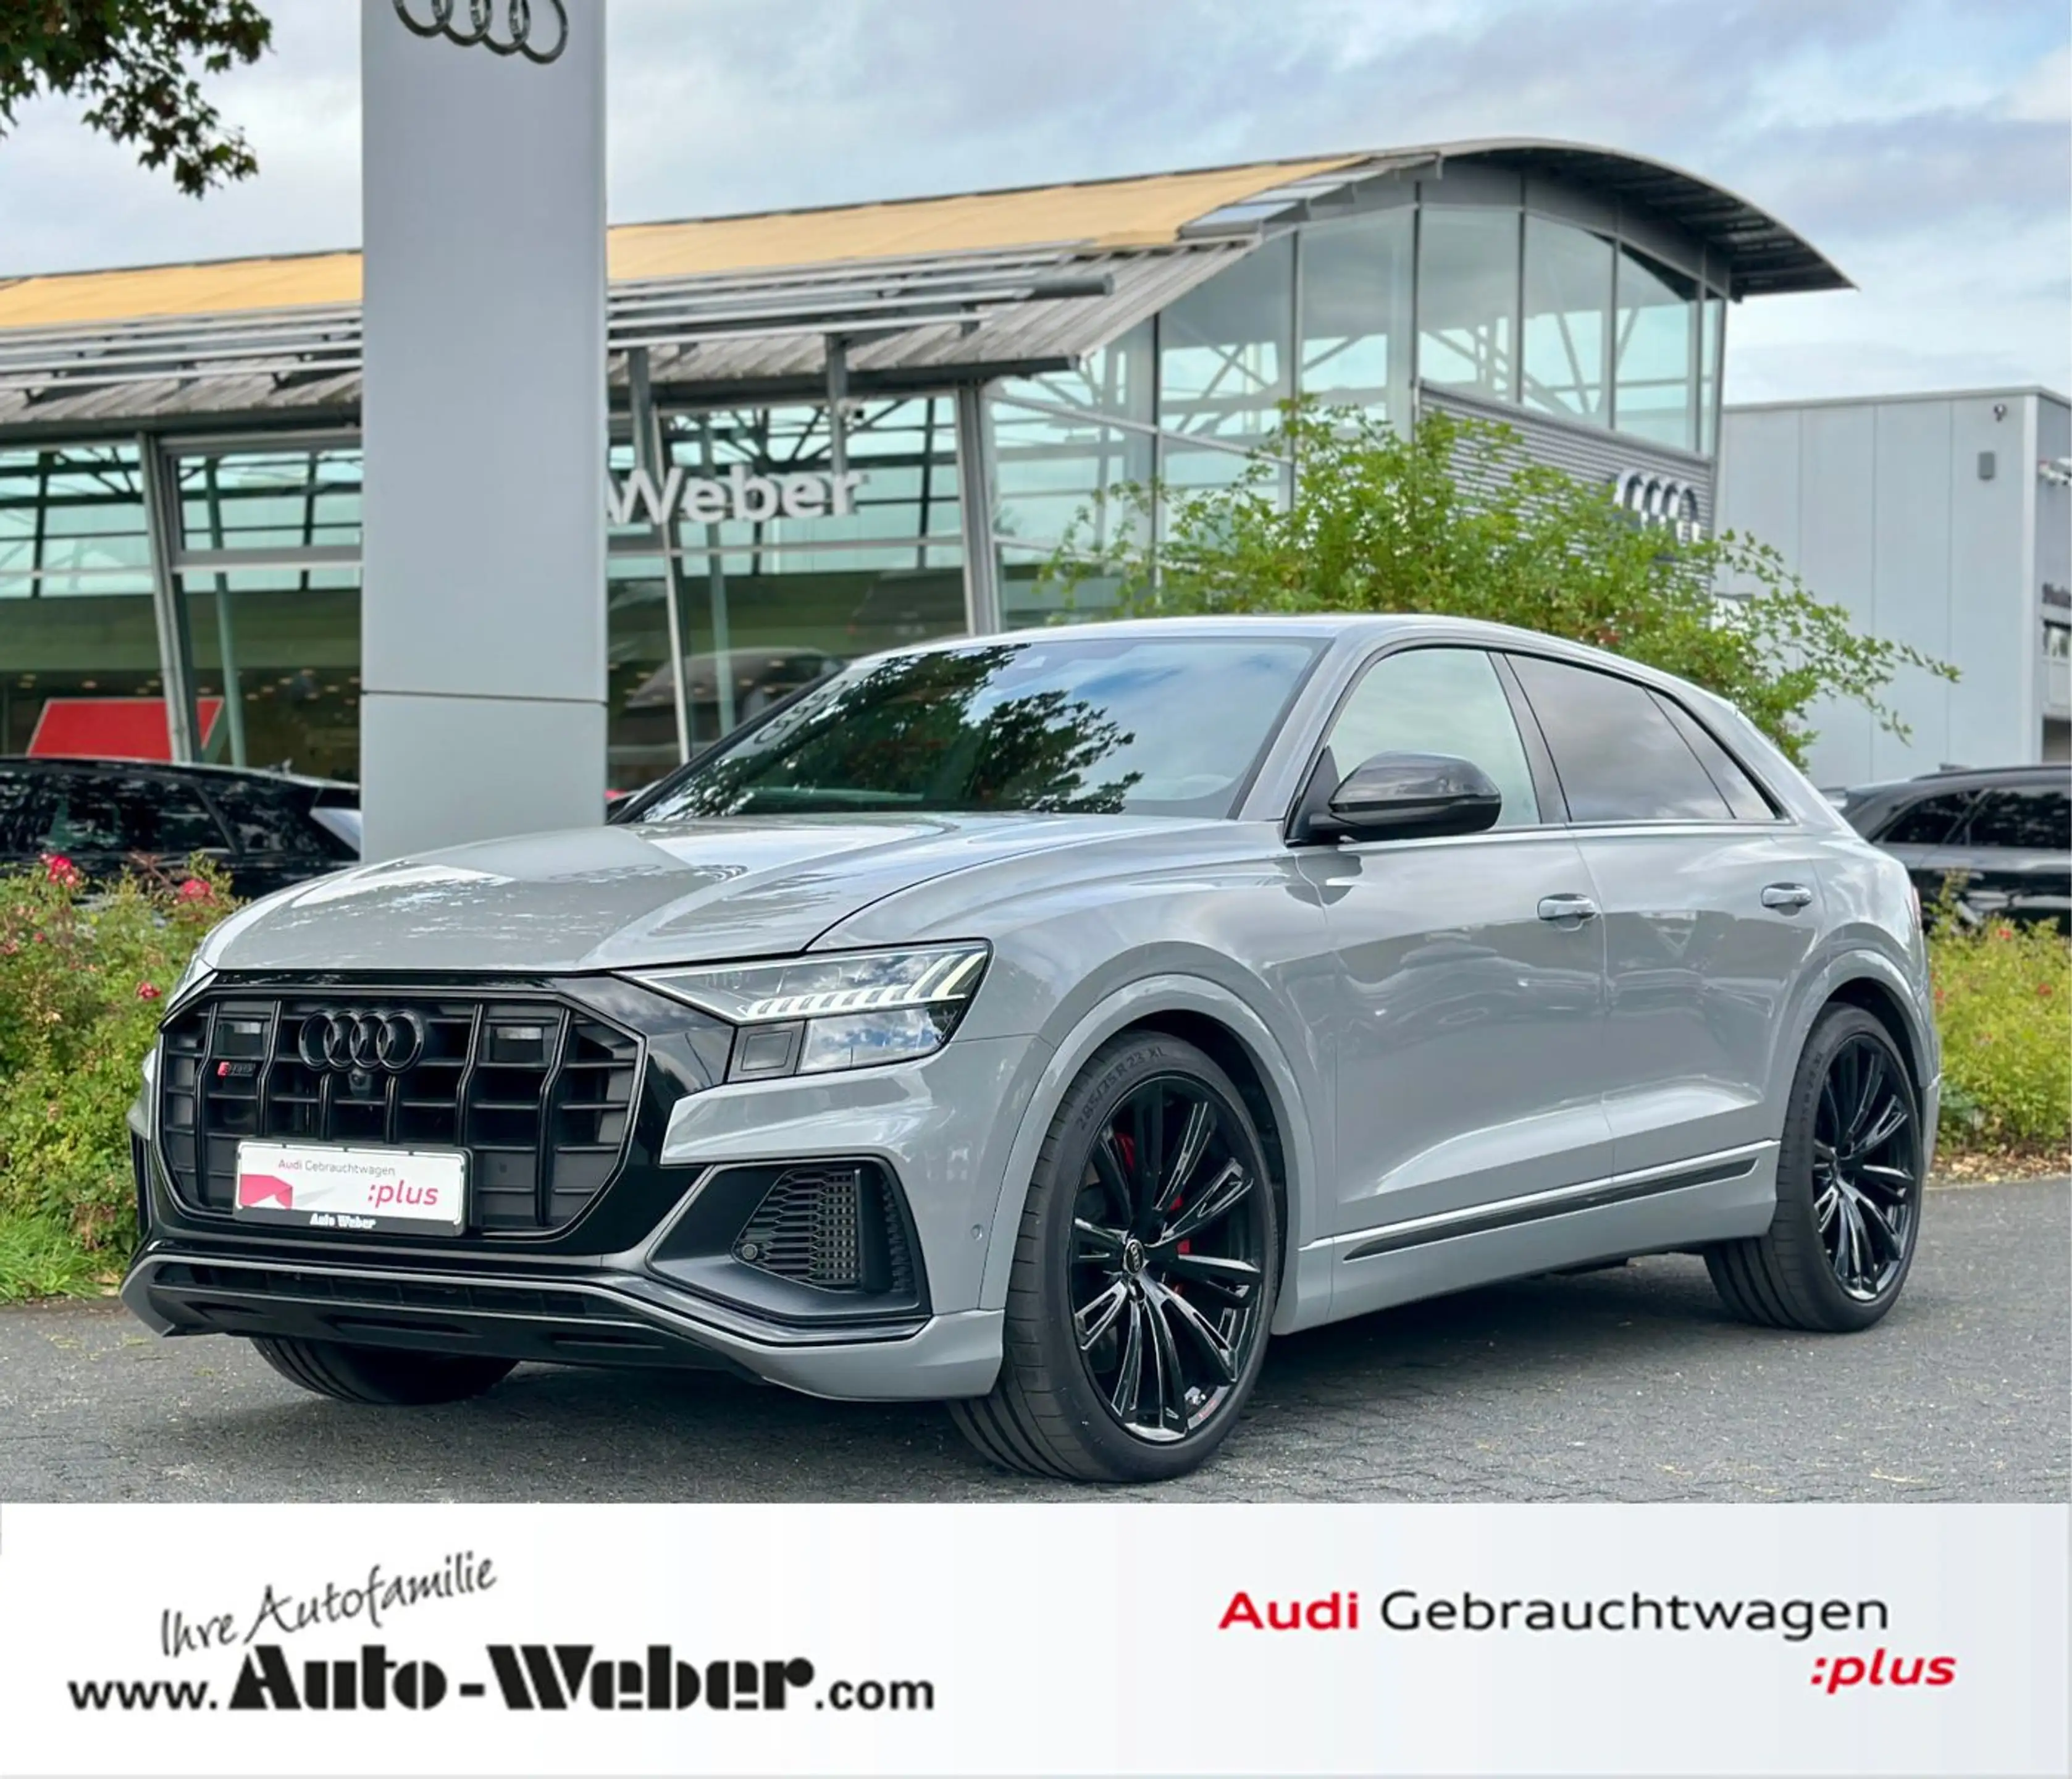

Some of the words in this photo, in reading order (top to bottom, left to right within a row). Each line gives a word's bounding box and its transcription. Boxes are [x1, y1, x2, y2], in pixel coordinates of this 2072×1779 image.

[606, 463, 861, 524] Weber
[279, 1158, 303, 1170] Audi
[304, 1161, 396, 1176] Gebrauchtwagen
[367, 1179, 438, 1208] :plus
